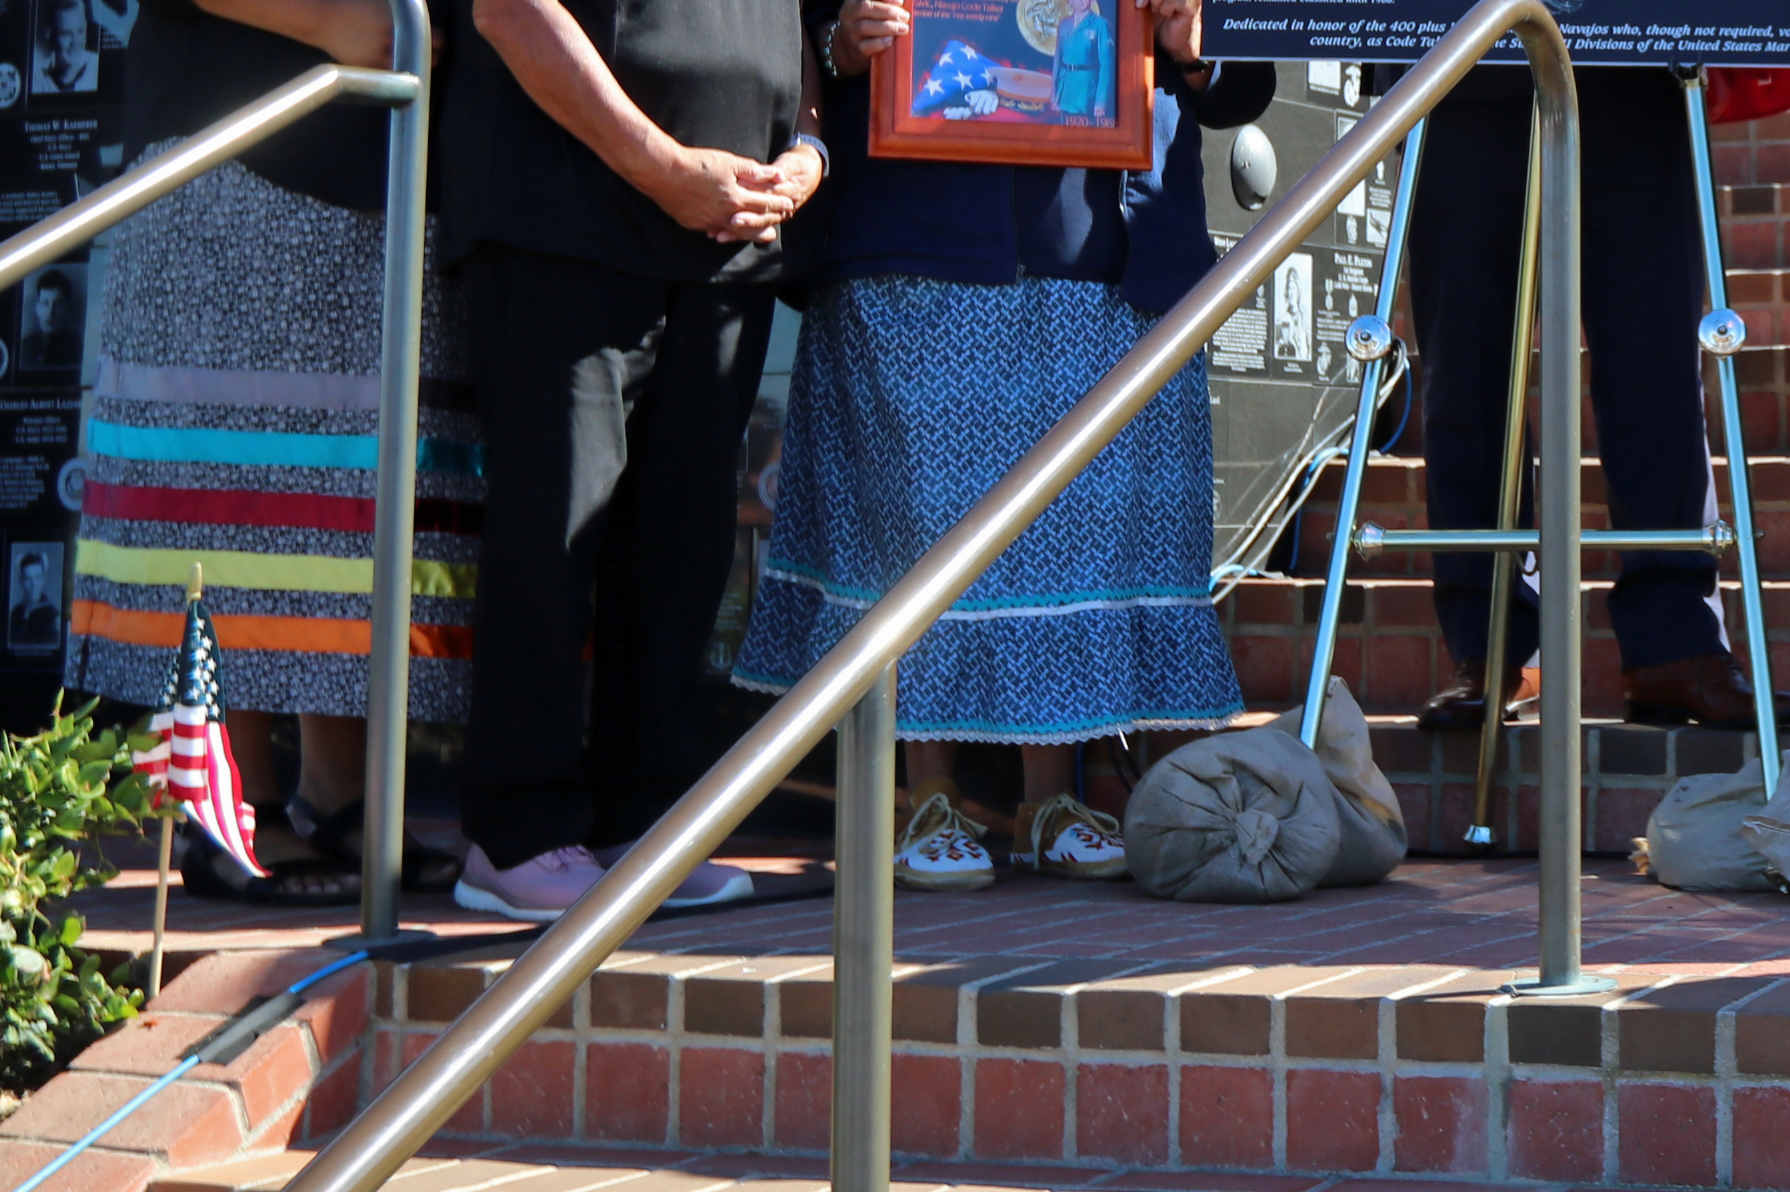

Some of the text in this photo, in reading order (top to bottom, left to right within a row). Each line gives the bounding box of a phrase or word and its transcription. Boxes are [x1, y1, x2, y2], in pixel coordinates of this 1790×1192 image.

[935, 1, 961, 11] Navajo
[983, 4, 1004, 12] Talker
[1223, 19, 1446, 36] Dedicated in honor of the 400 plus
[1558, 24, 1609, 38] Navajos
[1612, 24, 1642, 35] who,
[1646, 24, 1691, 38] though
[1694, 25, 1716, 36] not
[1718, 26, 1774, 39] required,
[1310, 36, 1417, 48] country, as Code
[1574, 39, 1634, 50] Divisions
[1636, 39, 1652, 50] of
[1653, 39, 1675, 50] the
[1678, 40, 1720, 51] United
[1722, 41, 1763, 52] States
[1065, 116, 1089, 126] 1920
